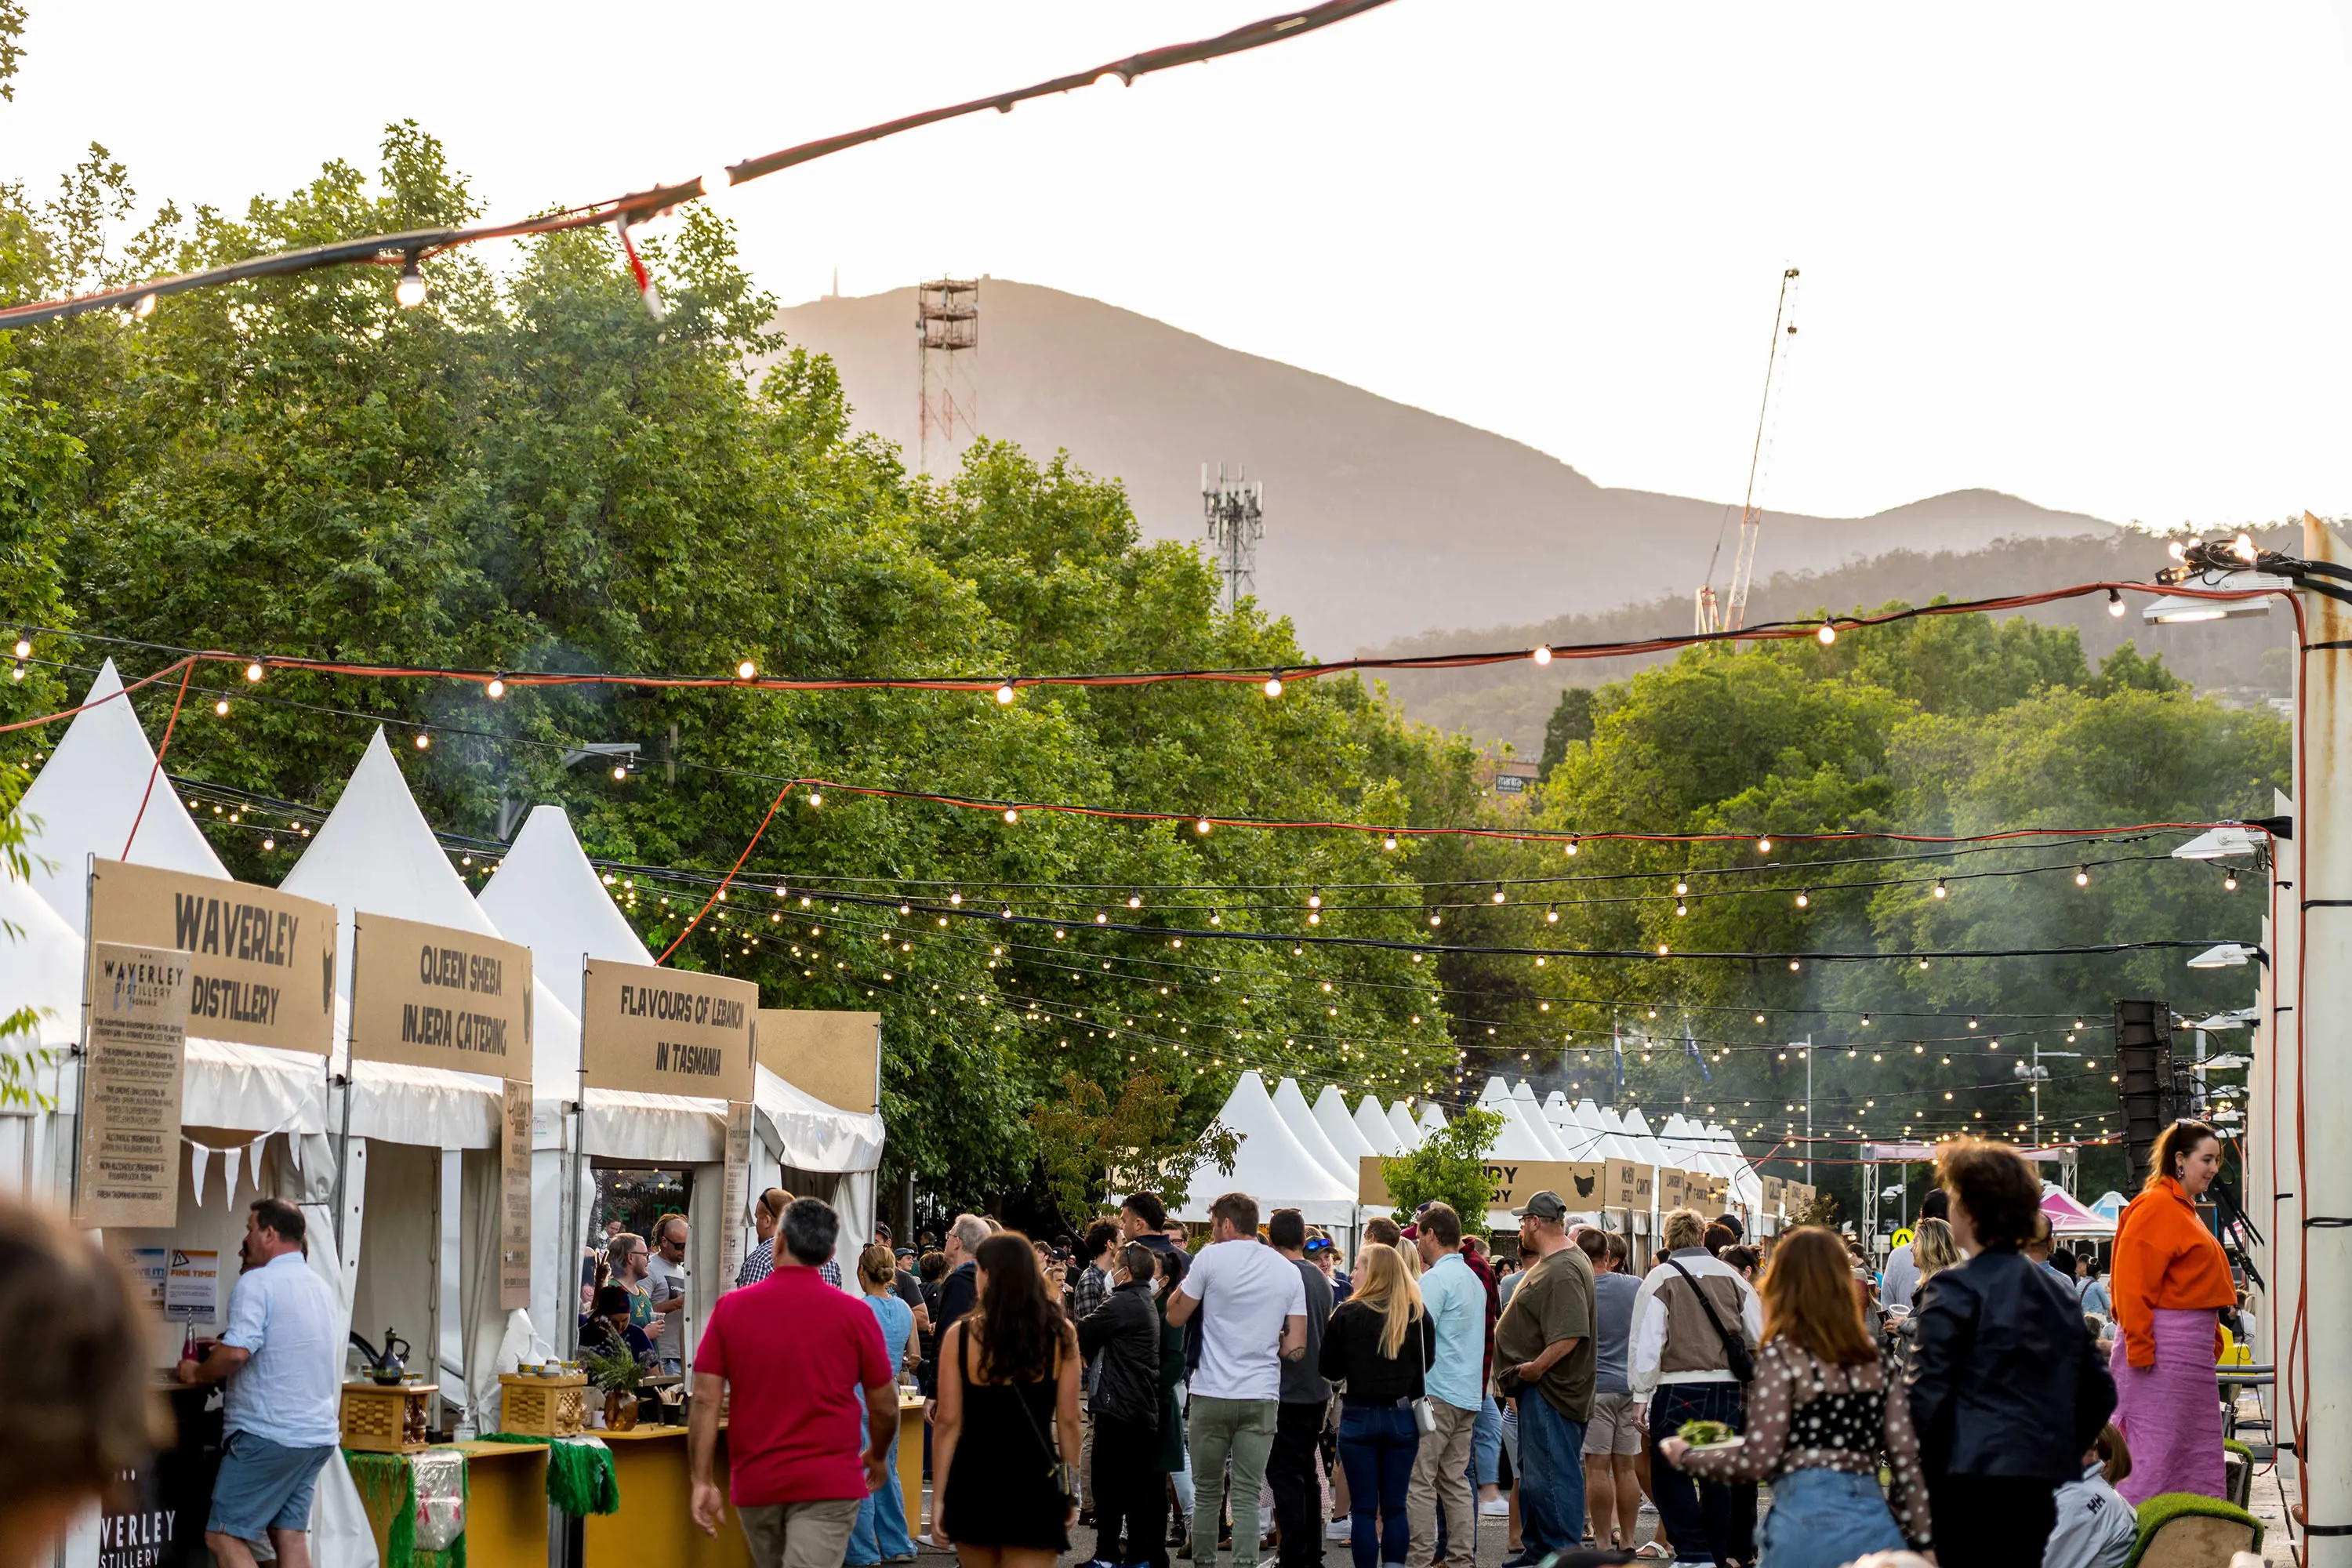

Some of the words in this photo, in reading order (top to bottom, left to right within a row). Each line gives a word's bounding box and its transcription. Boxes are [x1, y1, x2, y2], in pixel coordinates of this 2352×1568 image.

[176, 893, 299, 968] WAVERLEY
[104, 960, 183, 986] WAVERLEY
[115, 983, 171, 998] DISTILLERY
[420, 945, 467, 989] QUEEN
[470, 954, 502, 996] SHEBA
[191, 975, 280, 1025] DISTILLERY
[621, 985, 693, 1023] FLAVOURS
[695, 995, 710, 1024] OF
[711, 998, 744, 1029] LEBANON
[402, 1004, 452, 1047] INJERA
[456, 1011, 506, 1056] CATERING
[656, 1042, 669, 1071] IN
[673, 1044, 721, 1076] TASMANIA
[2086, 1493, 2107, 1515] HH
[101, 1510, 176, 1550] VERLEY
